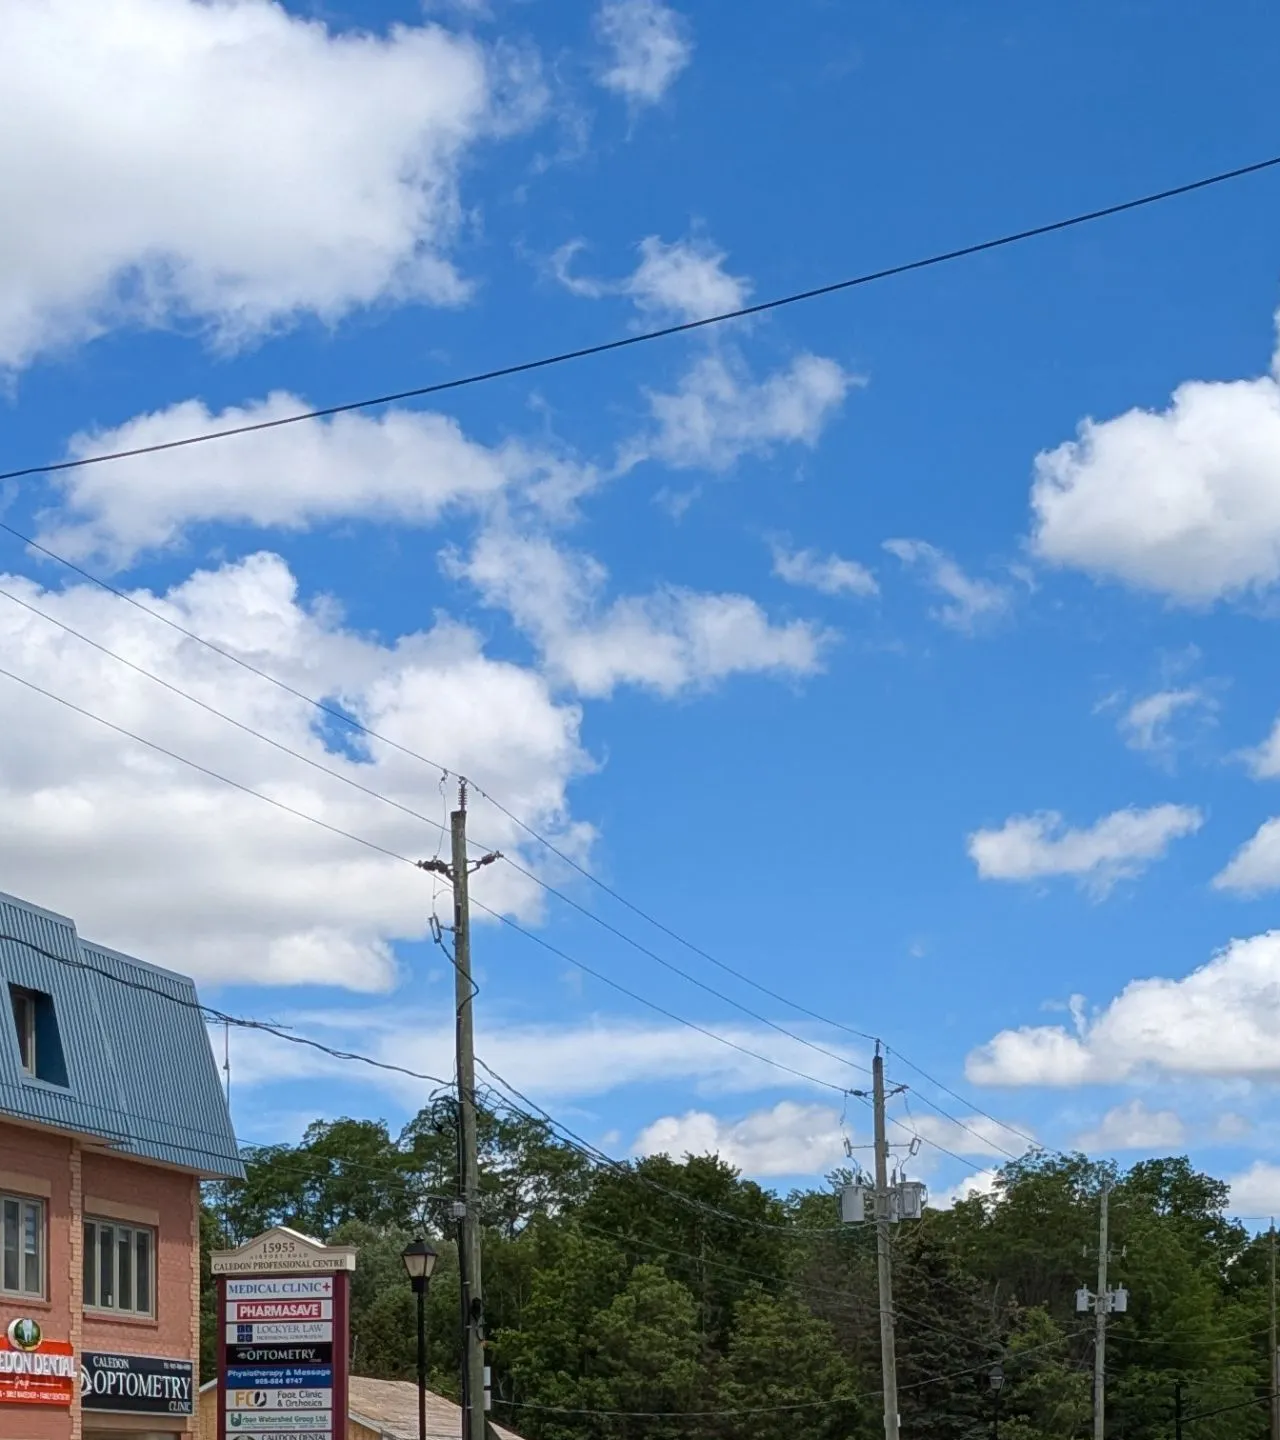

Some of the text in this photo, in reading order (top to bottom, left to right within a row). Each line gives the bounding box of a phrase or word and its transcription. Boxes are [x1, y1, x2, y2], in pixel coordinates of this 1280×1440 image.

[262, 1242, 295, 1254] 15955
[214, 1258, 344, 1271] CALEDON PROFESSIONAL CENTRE
[228, 1282, 321, 1294] MEDICAL CLINIC
[240, 1304, 319, 1318] PHARMASAVE
[257, 1324, 322, 1334] LOCKYER LAW
[247, 1349, 316, 1360] OPTOMETRY
[34, 1353, 77, 1377] DENTAL
[93, 1356, 129, 1369] CALEDON
[227, 1369, 283, 1378] Physiotherapy
[294, 1368, 331, 1377] Massage
[94, 1370, 191, 1399] OPTOMETRY
[277, 1391, 297, 1399] Foot
[299, 1390, 322, 1399] Clinic
[169, 1401, 191, 1412] CLINIC
[285, 1399, 322, 1407] Orthotics
[260, 1415, 293, 1423] Watershed
[294, 1415, 313, 1424] Group
